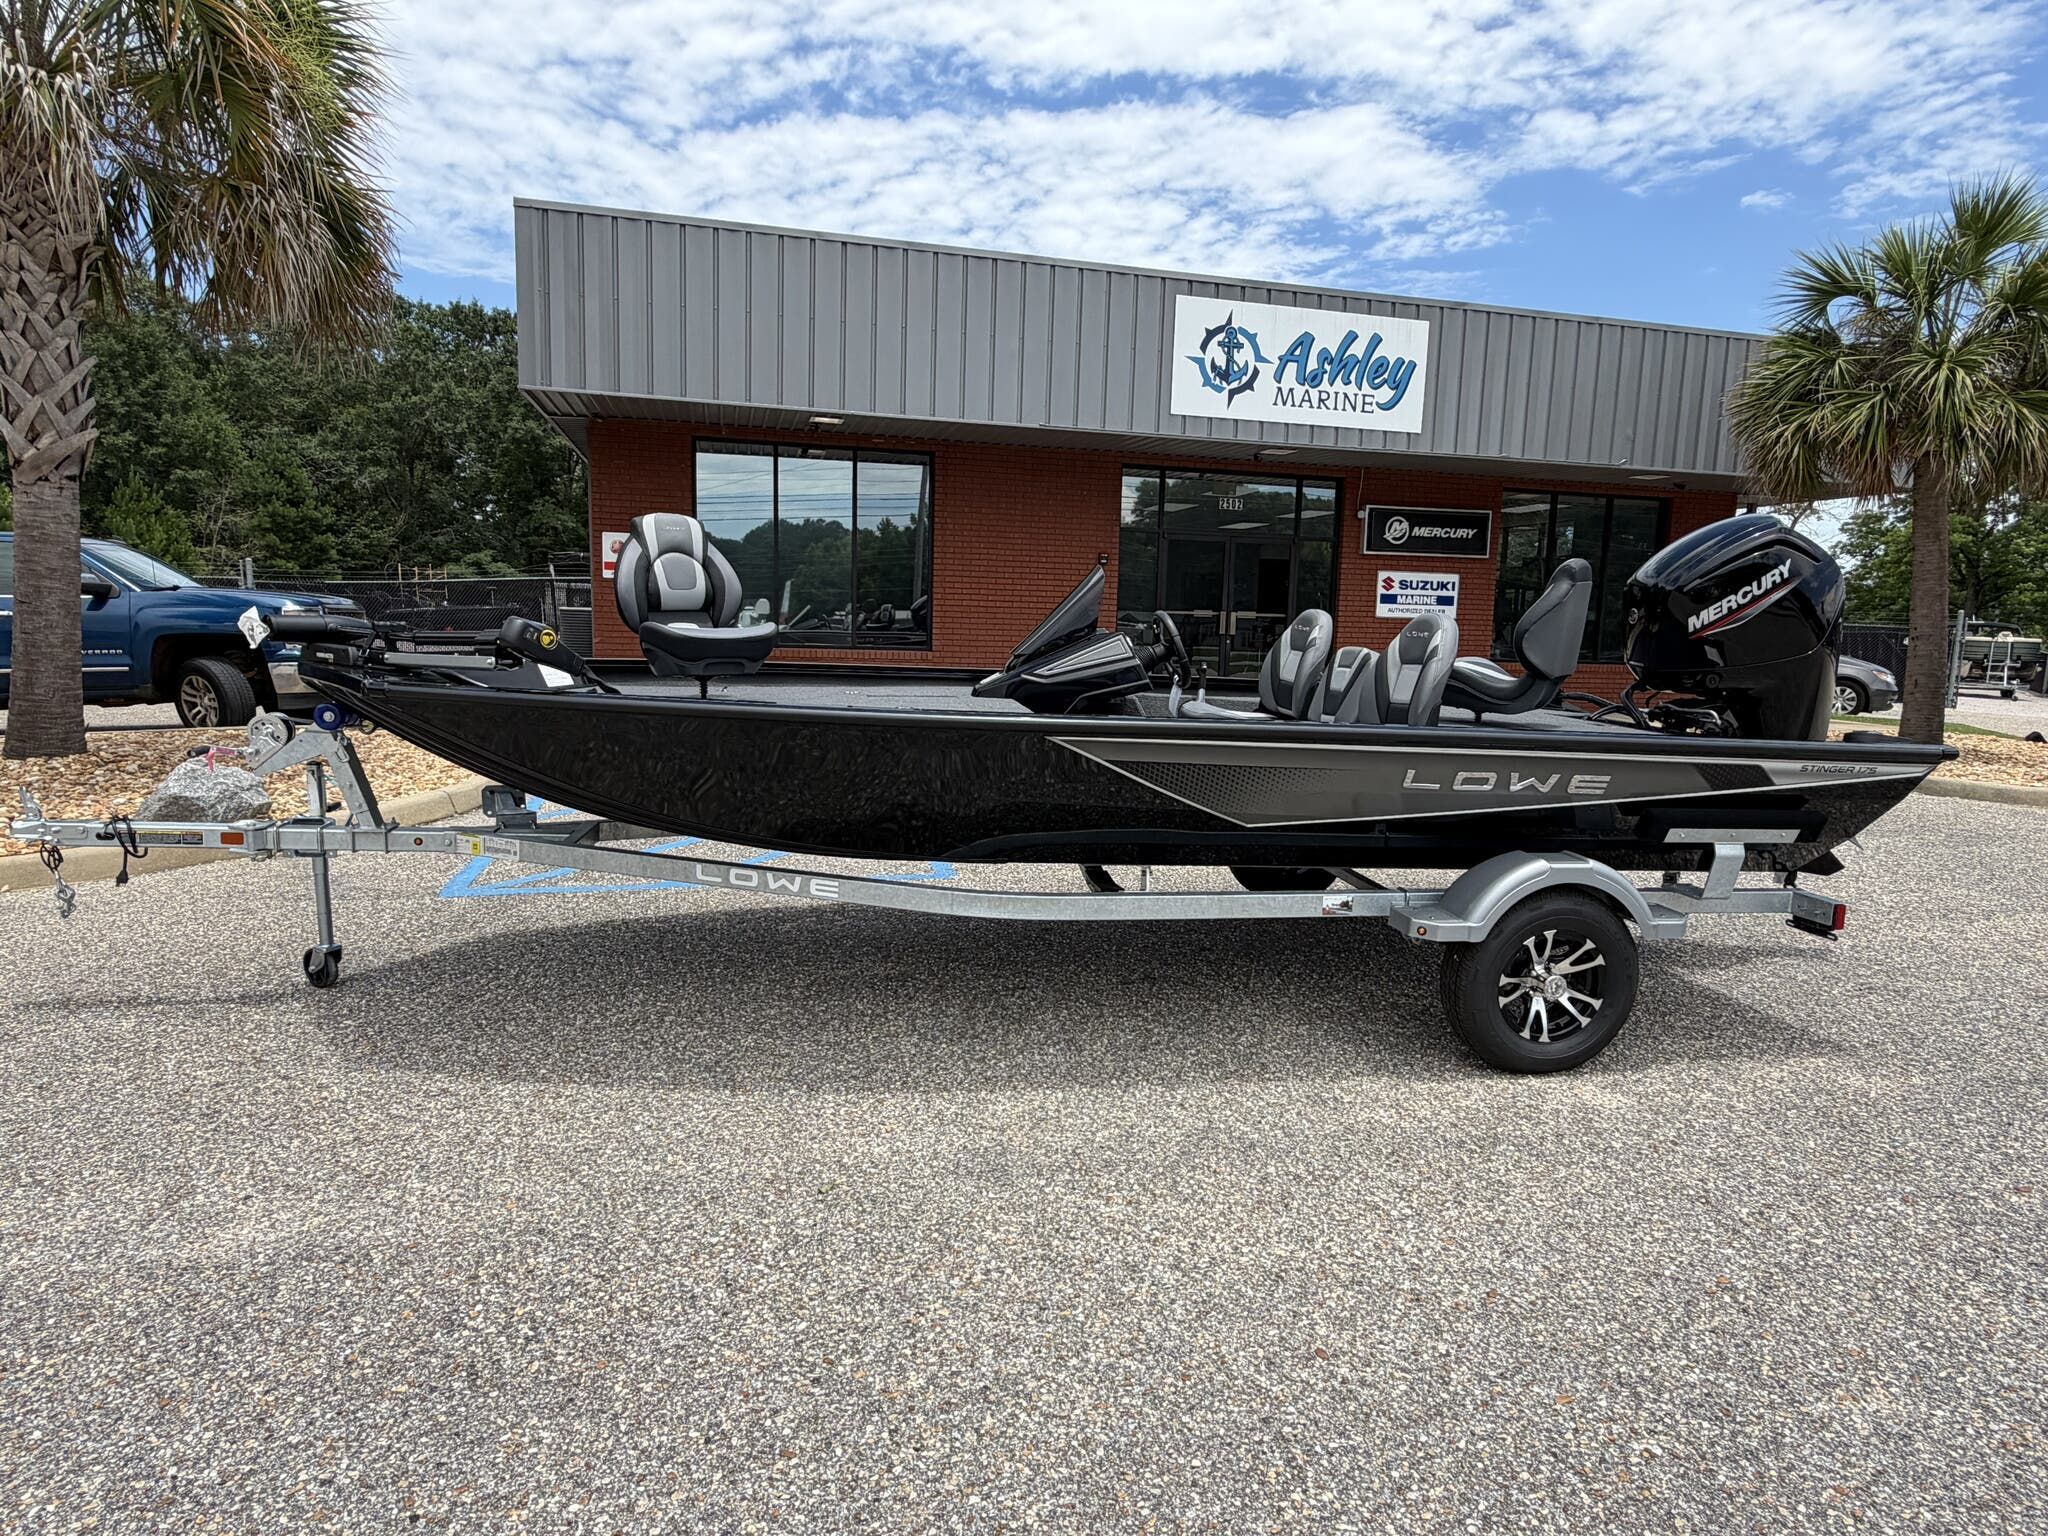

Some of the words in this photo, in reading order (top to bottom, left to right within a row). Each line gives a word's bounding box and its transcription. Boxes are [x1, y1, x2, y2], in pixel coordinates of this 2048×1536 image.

[1273, 329, 1417, 411] Ashley
[1272, 386, 1376, 414] MARINE
[1219, 498, 1243, 510] 2502
[1411, 526, 1478, 539] MERCURY
[1398, 579, 1456, 592] SUZUKI
[1396, 594, 1438, 605] MARINE
[1688, 558, 1792, 633] MERCURY
[1800, 764, 1855, 774] STINGER
[1857, 766, 1878, 775] 175
[1402, 769, 1612, 794] LOWE
[696, 864, 839, 898] LOWE
